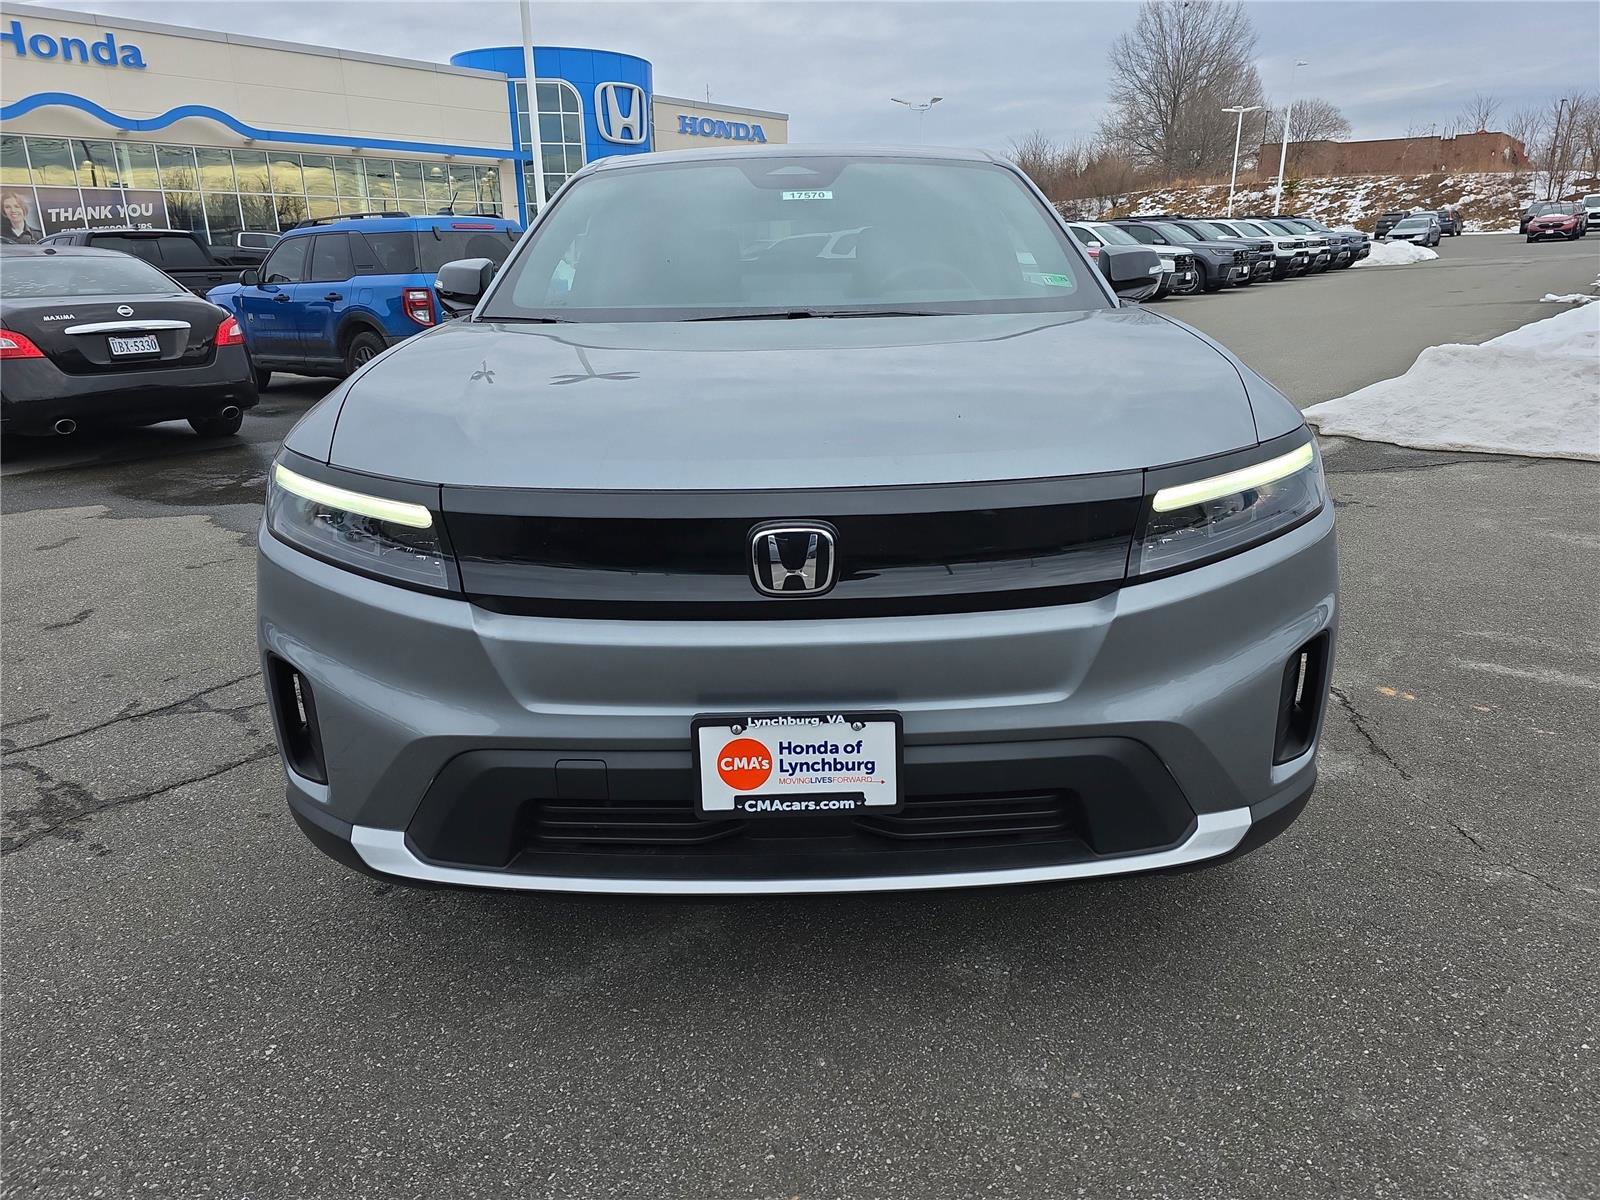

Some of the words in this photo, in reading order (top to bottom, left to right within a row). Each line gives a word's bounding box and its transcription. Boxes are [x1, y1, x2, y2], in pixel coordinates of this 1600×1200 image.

[0, 20, 147, 68] Honda
[678, 114, 767, 144] HONDA
[789, 191, 825, 199] 17570
[48, 205, 112, 222] THANK
[116, 203, 153, 218] YOU
[43, 314, 75, 322] MAXIMA
[111, 339, 157, 353] UBX-5330
[747, 716, 823, 729] Lynchburg,
[827, 715, 845, 724] VA
[778, 741, 839, 755] Honda
[843, 740, 863, 754] of
[720, 756, 770, 772] CMA's
[779, 758, 876, 776] Lynchburg
[744, 798, 855, 812] CMAcars.com
